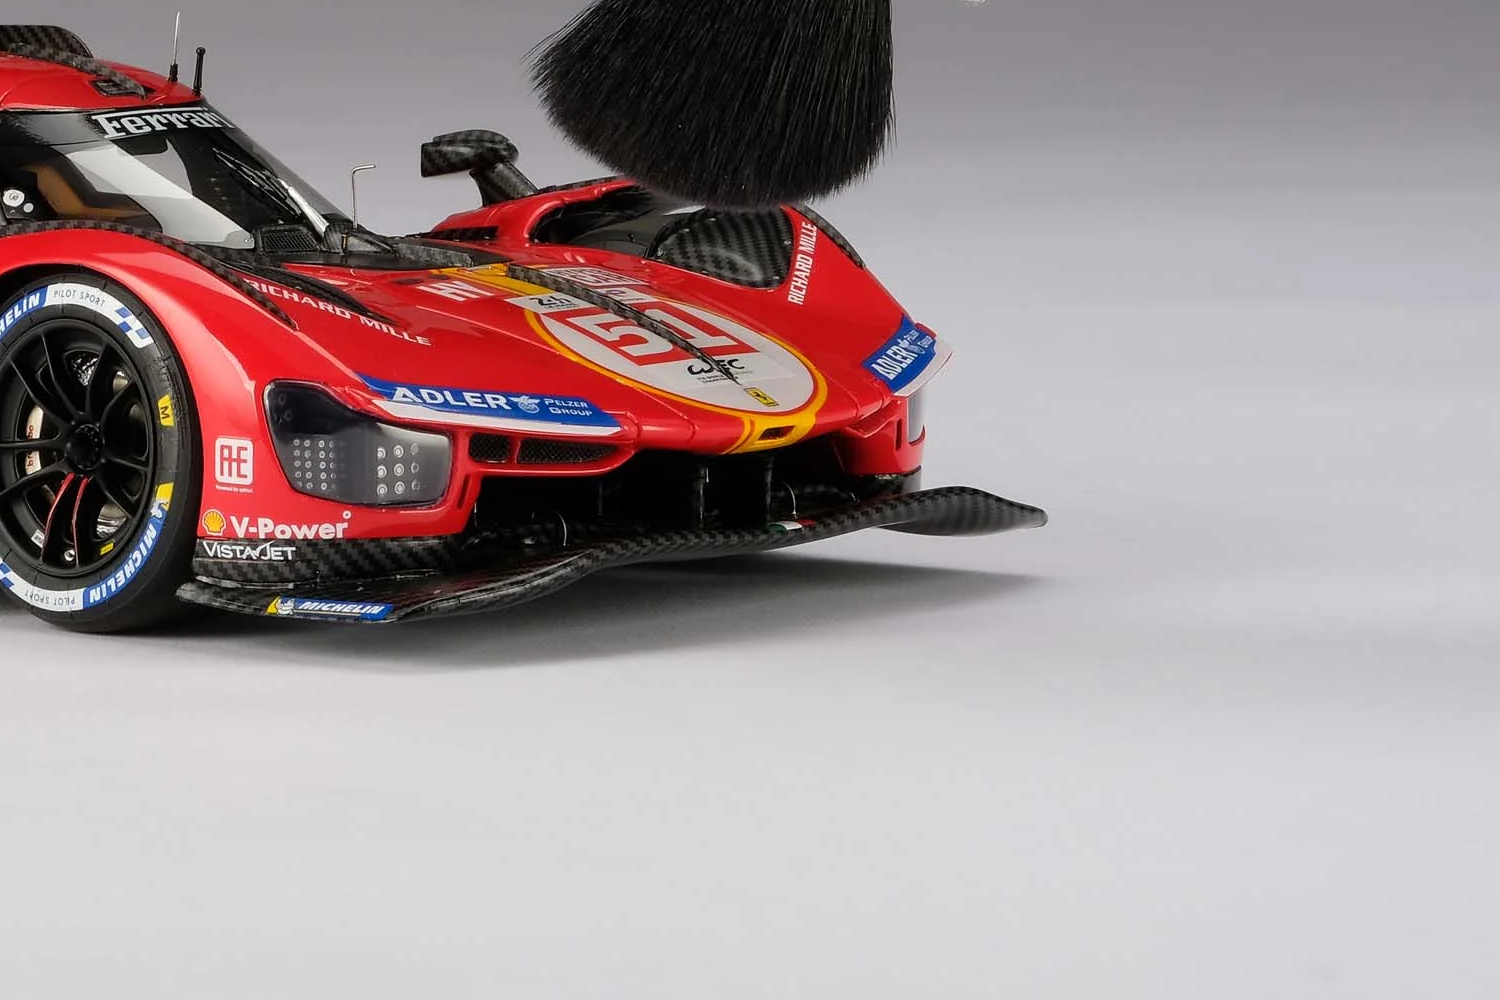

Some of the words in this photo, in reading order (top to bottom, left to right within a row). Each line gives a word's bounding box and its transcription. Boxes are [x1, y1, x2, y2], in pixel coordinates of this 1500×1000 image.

[799, 221, 818, 254] MILLE
[788, 254, 813, 305] RICHARD
[53, 289, 77, 299] PILOT
[79, 291, 105, 307] SPORT
[244, 278, 351, 319] RICHARD
[359, 315, 432, 346] MILLE
[565, 309, 739, 356] 51
[871, 345, 918, 380] ADLER
[389, 387, 512, 410] ADLER
[230, 515, 349, 539] V-Power
[90, 525, 157, 603] MICHELIN
[24, 589, 50, 605] SPORT
[53, 596, 75, 606] PILOT
[298, 602, 386, 614] MICHELIN
